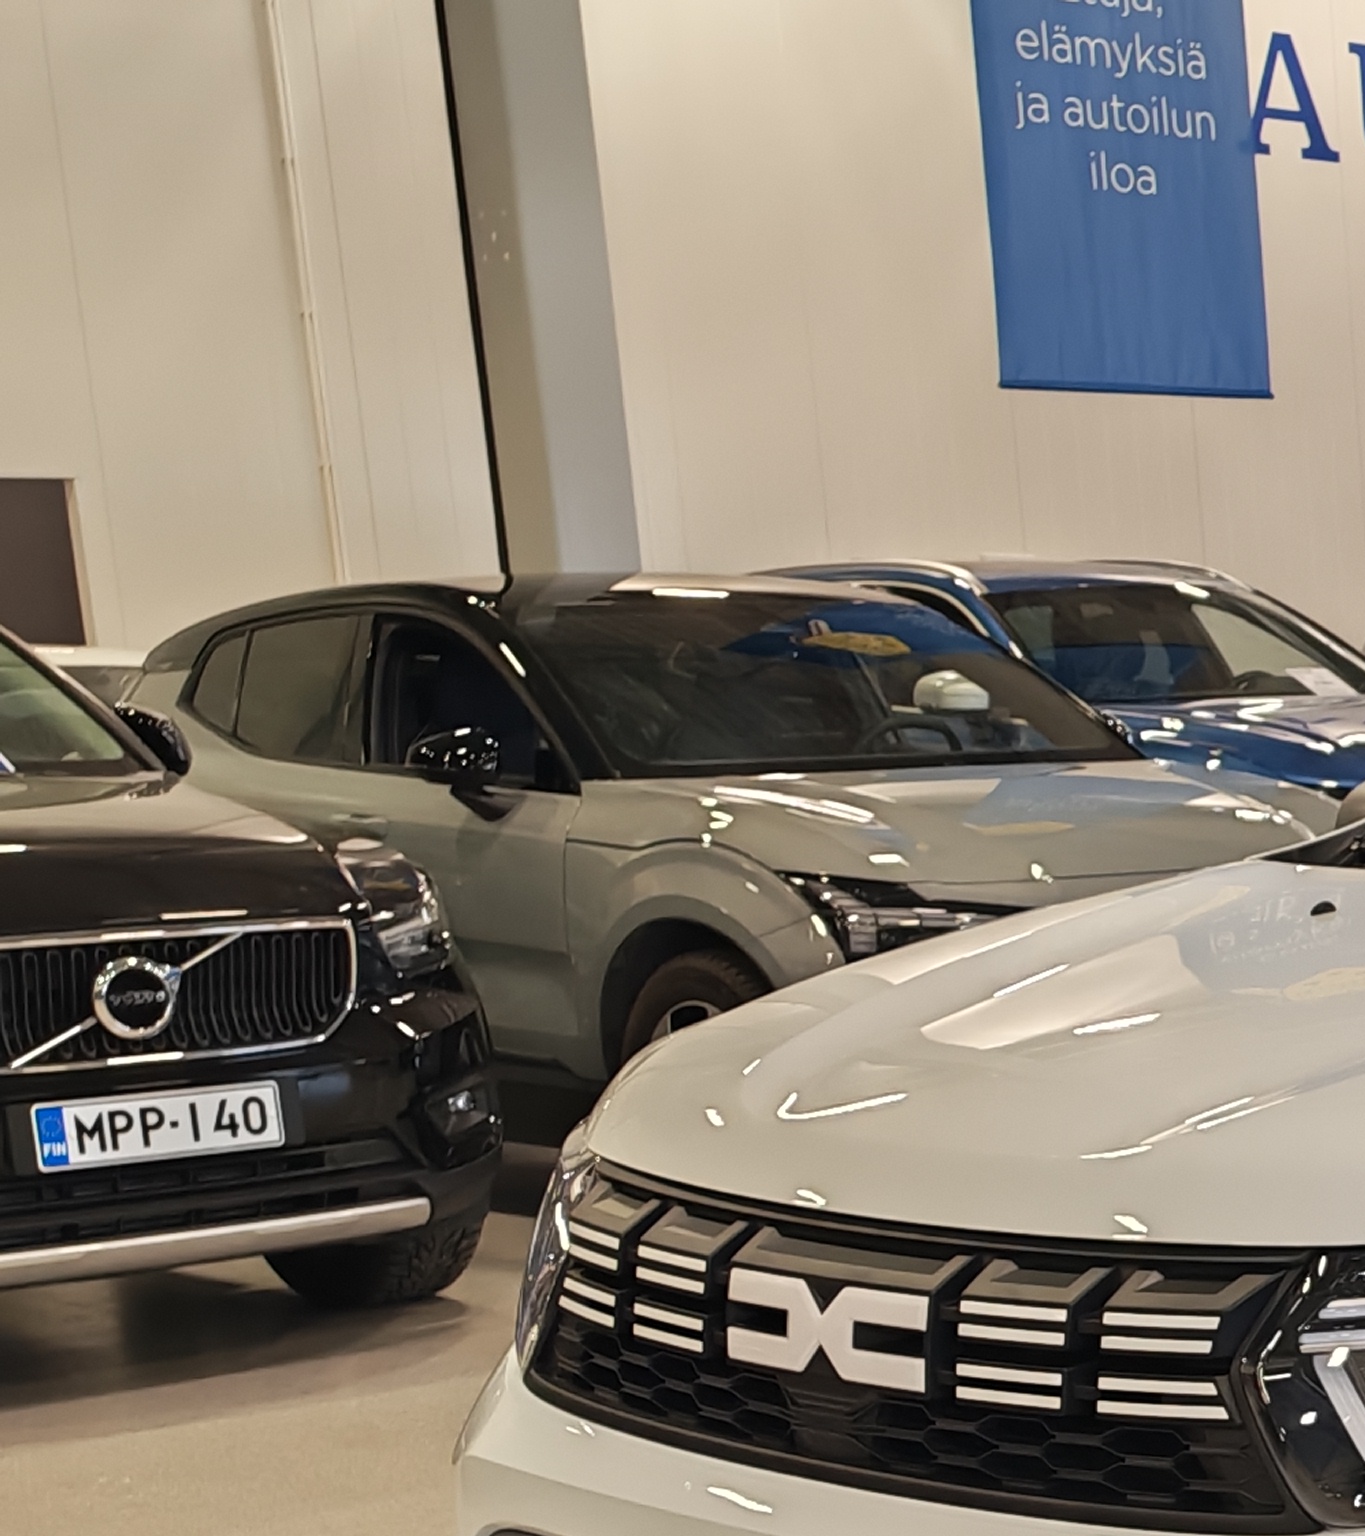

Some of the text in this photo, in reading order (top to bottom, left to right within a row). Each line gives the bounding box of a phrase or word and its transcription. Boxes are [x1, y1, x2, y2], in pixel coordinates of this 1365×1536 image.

[1015, 20, 1207, 80] elämyksiä
[1014, 80, 1217, 141] ja autoilun
[1089, 150, 1157, 195] iloa
[43, 1140, 66, 1158] FIN
